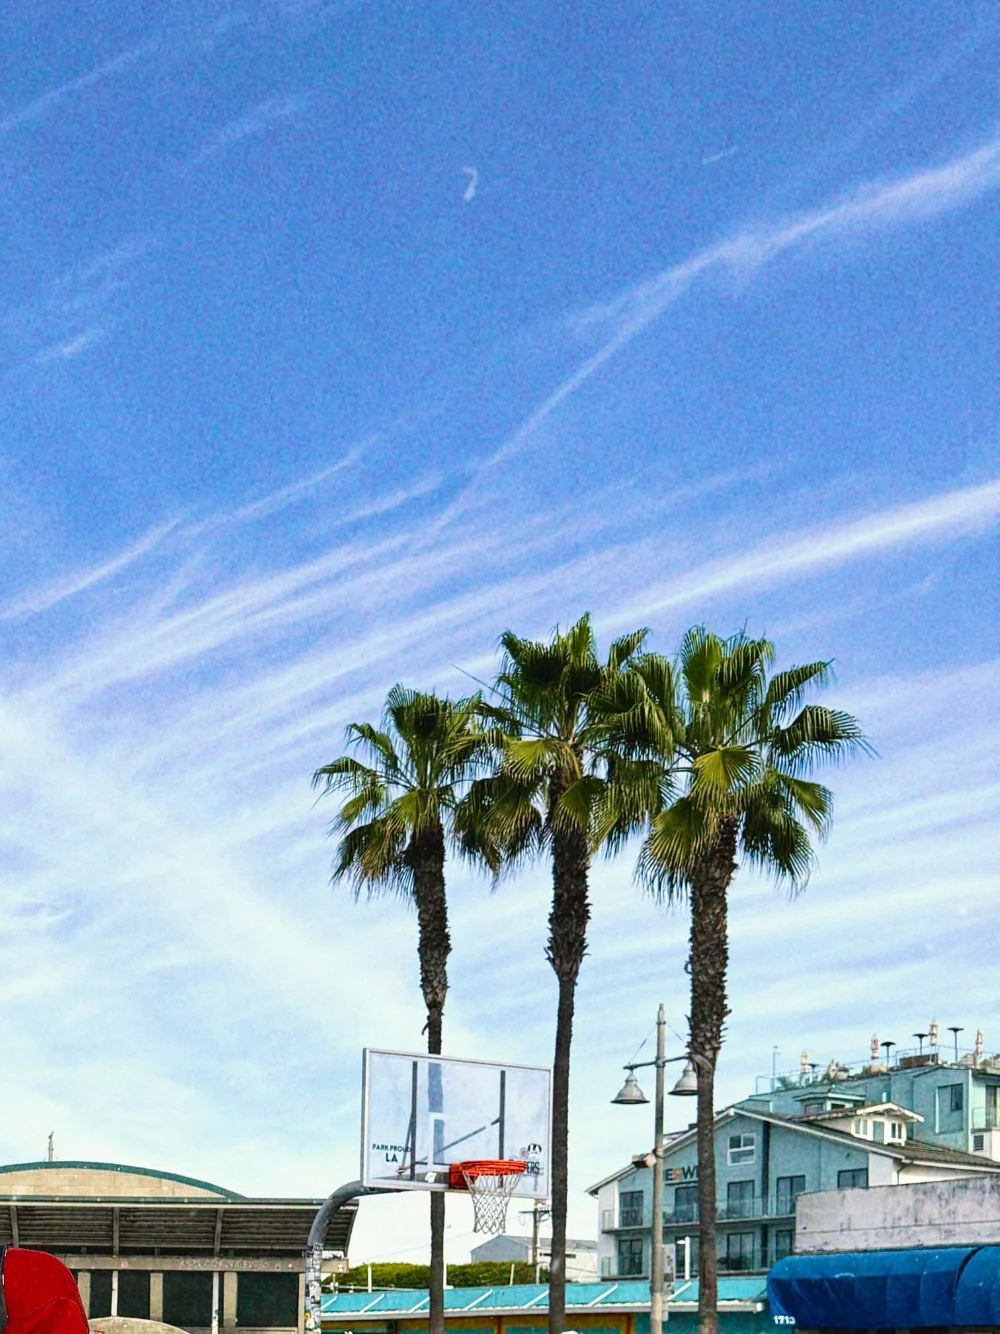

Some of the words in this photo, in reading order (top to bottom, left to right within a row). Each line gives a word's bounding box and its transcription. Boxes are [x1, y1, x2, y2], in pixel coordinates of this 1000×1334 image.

[372, 1143, 389, 1151] PARK
[530, 1143, 540, 1154] LA
[385, 1153, 398, 1163] LA
[773, 1315, 796, 1325] 1713
